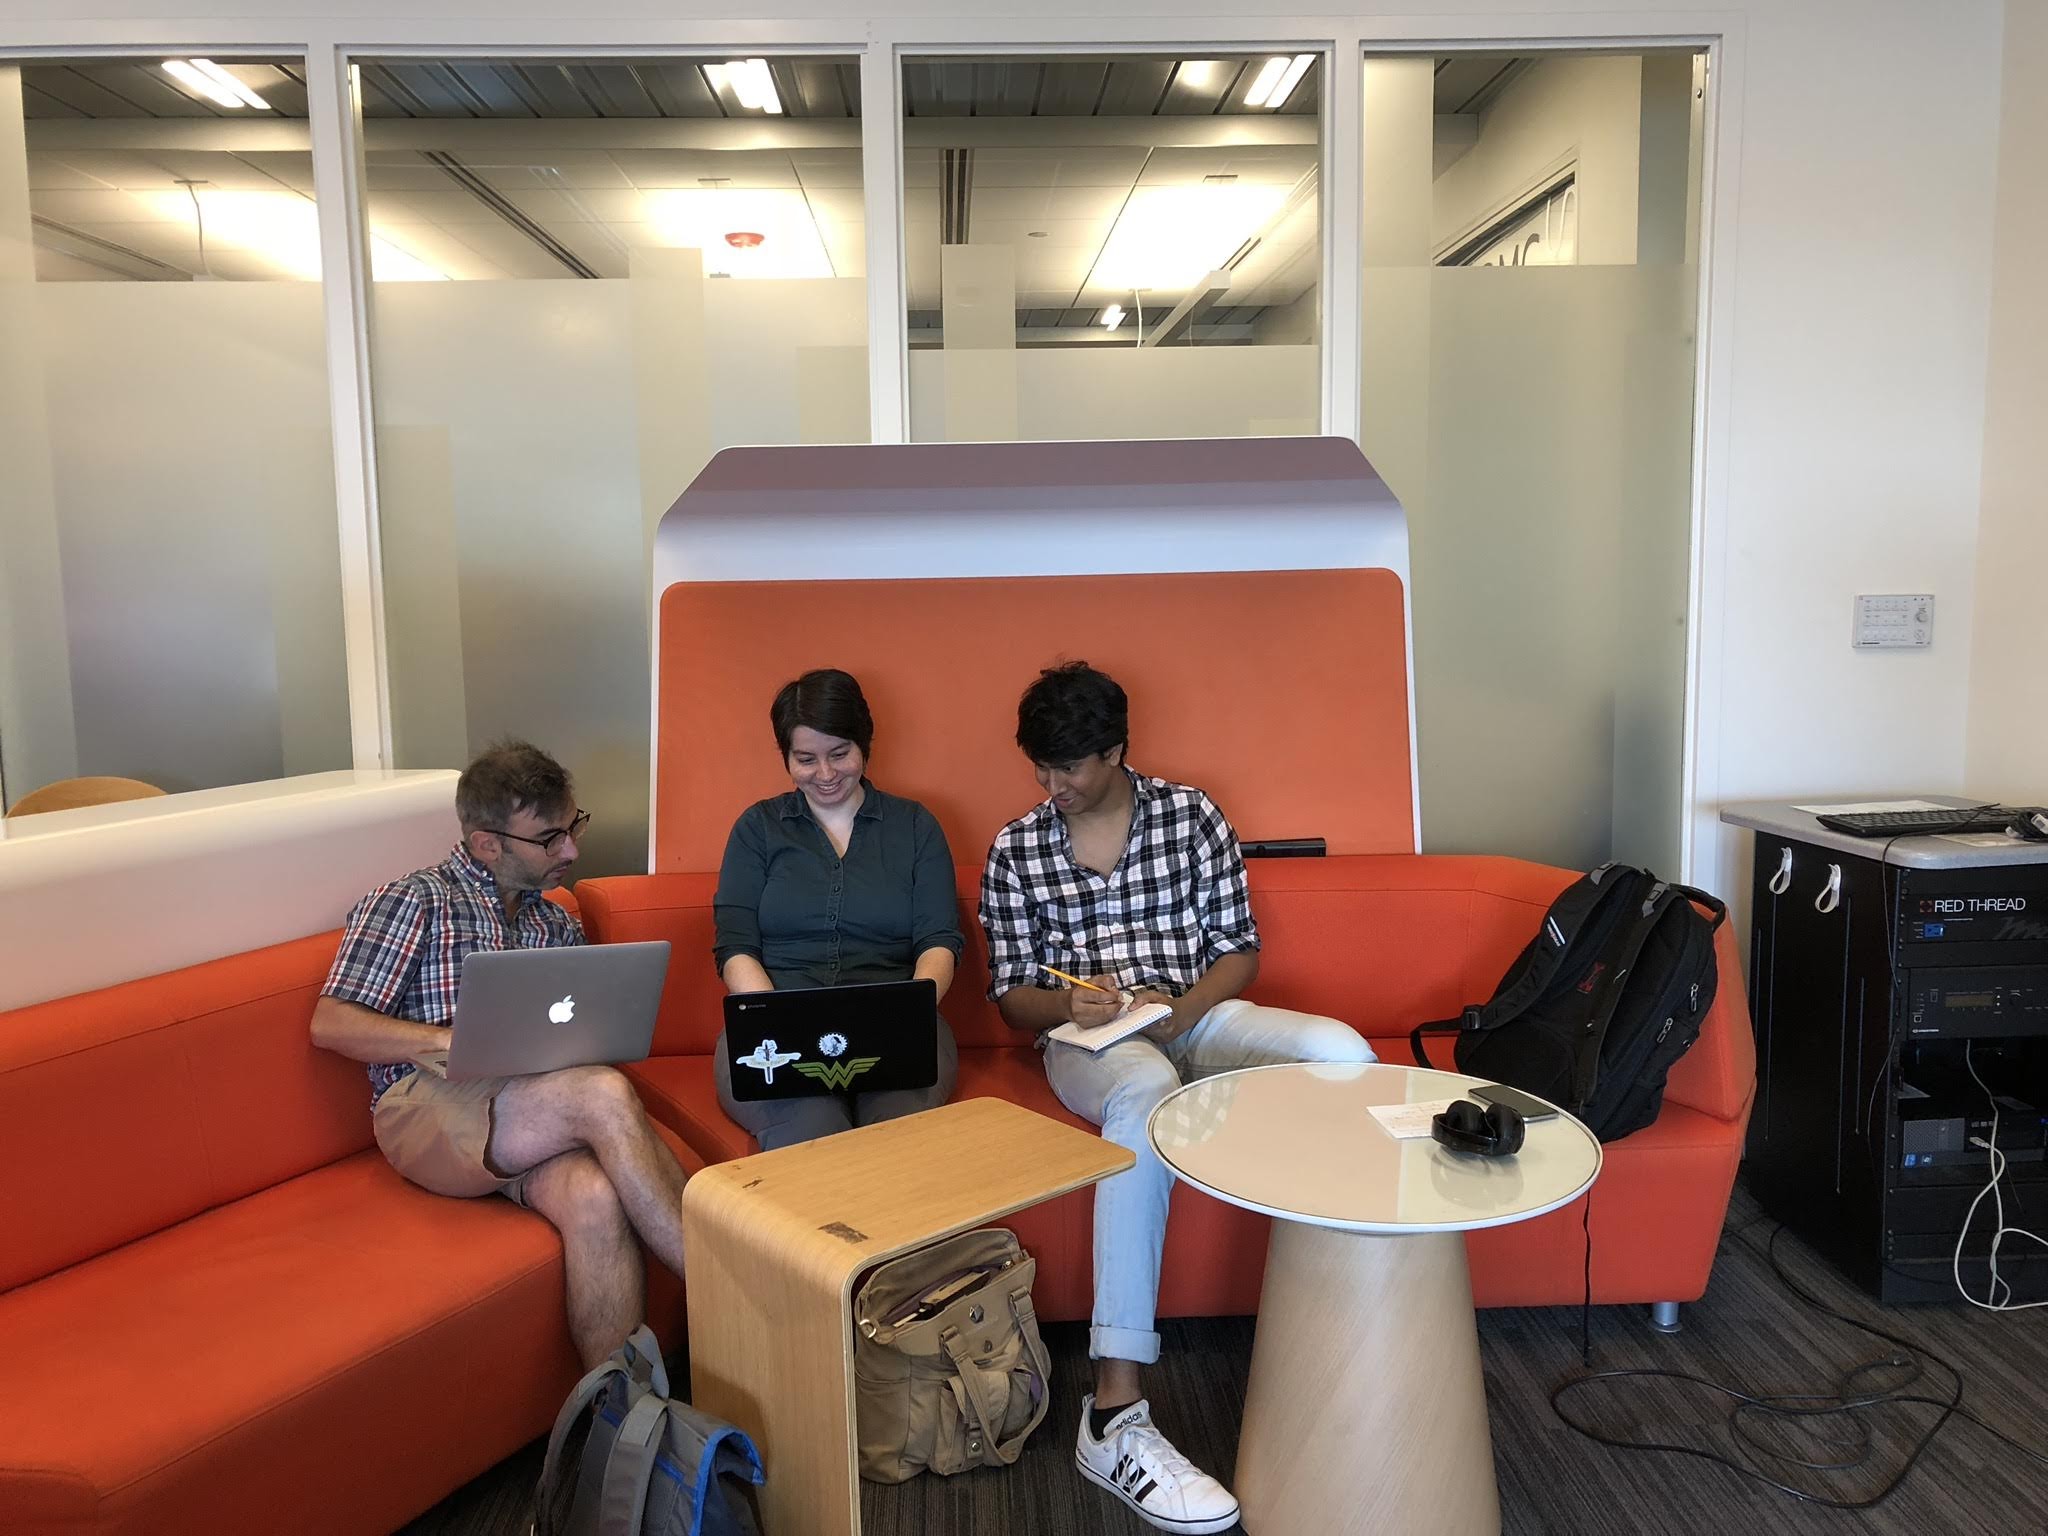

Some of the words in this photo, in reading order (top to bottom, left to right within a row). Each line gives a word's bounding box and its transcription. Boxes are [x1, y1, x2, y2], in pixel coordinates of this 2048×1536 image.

[1934, 899, 1965, 913] RED
[1966, 897, 2027, 912] THREAD
[1115, 1411, 1143, 1430] adidas
